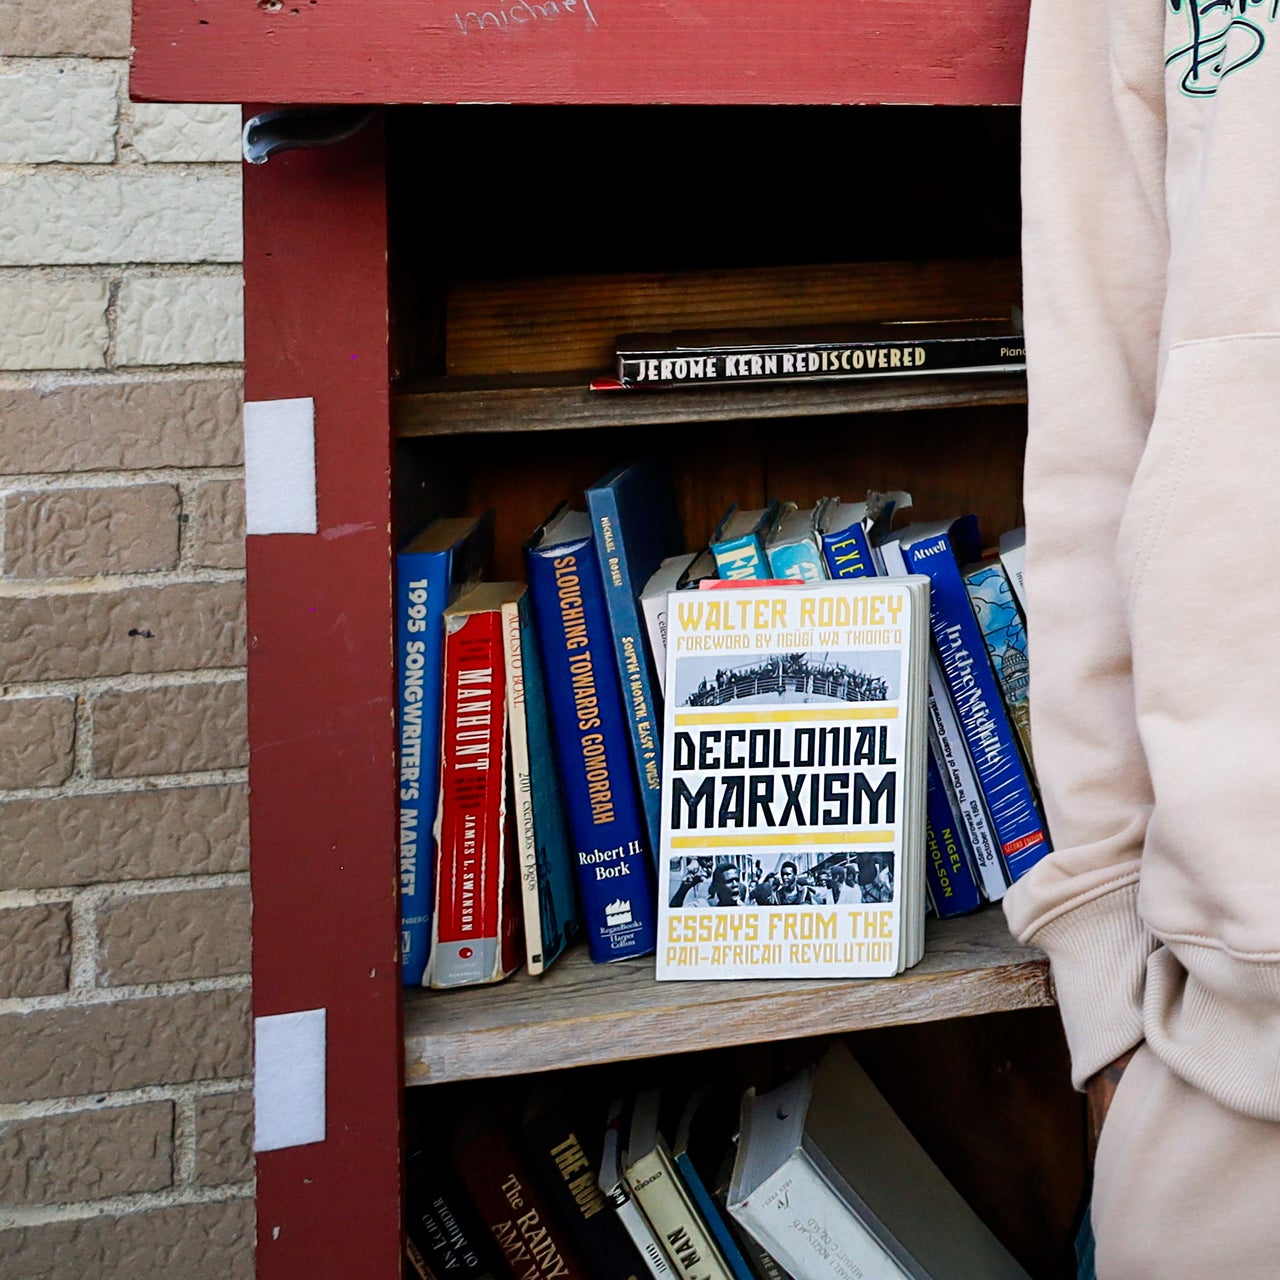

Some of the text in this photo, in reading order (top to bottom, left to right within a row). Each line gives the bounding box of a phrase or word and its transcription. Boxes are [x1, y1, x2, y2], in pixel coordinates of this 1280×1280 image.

[636, 357, 718, 383] JEROME
[725, 354, 778, 378] KERN
[783, 346, 927, 375] REDISCOVERED
[830, 537, 864, 580] EXE
[912, 539, 948, 563] Atwell
[608, 556, 625, 588] ROSEN
[677, 594, 904, 632] WALTER RODNEY
[676, 633, 750, 652] FOREWORD
[755, 632, 772, 649] BY
[818, 630, 840, 647] WA
[844, 628, 903, 647] THIONG'O
[508, 611, 526, 709] AUGUSTO BOAL
[553, 555, 616, 826] SLOUCHING TOWARDS GOMORRAH
[621, 635, 641, 674] SOUTH
[637, 721, 655, 750] EAST
[400, 578, 429, 897] 1995 SONGWRITER'S MARKET
[454, 666, 493, 772] MANHUNT
[672, 724, 897, 772] DECOLONIAL
[944, 738, 955, 760] Adam
[518, 771, 532, 794] 200
[952, 770, 964, 790] Diary
[670, 770, 897, 830] MARXISM
[463, 813, 477, 856] JAMES
[578, 840, 643, 866] Robert H.
[941, 828, 962, 874] NIGEL
[981, 833, 994, 861] October
[463, 858, 476, 872] L.
[594, 861, 631, 881] Bork
[926, 816, 954, 898] ICHOLSON
[975, 849, 987, 868] Adam
[523, 862, 538, 892] jogos
[461, 872, 475, 933] SWANSON
[667, 910, 895, 944] ESSAYS FROM THE
[665, 941, 894, 967] PAN-AFRICAN REVOLUTION
[550, 1132, 591, 1181] THE
[421, 1213, 448, 1251] ECHO
[432, 1196, 468, 1251] MURDER
[490, 1219, 532, 1266] AMY
[501, 1173, 525, 1211] The
[516, 1206, 570, 1280] RAINY
[444, 1250, 461, 1270] AN
[666, 1225, 702, 1271] MAN
